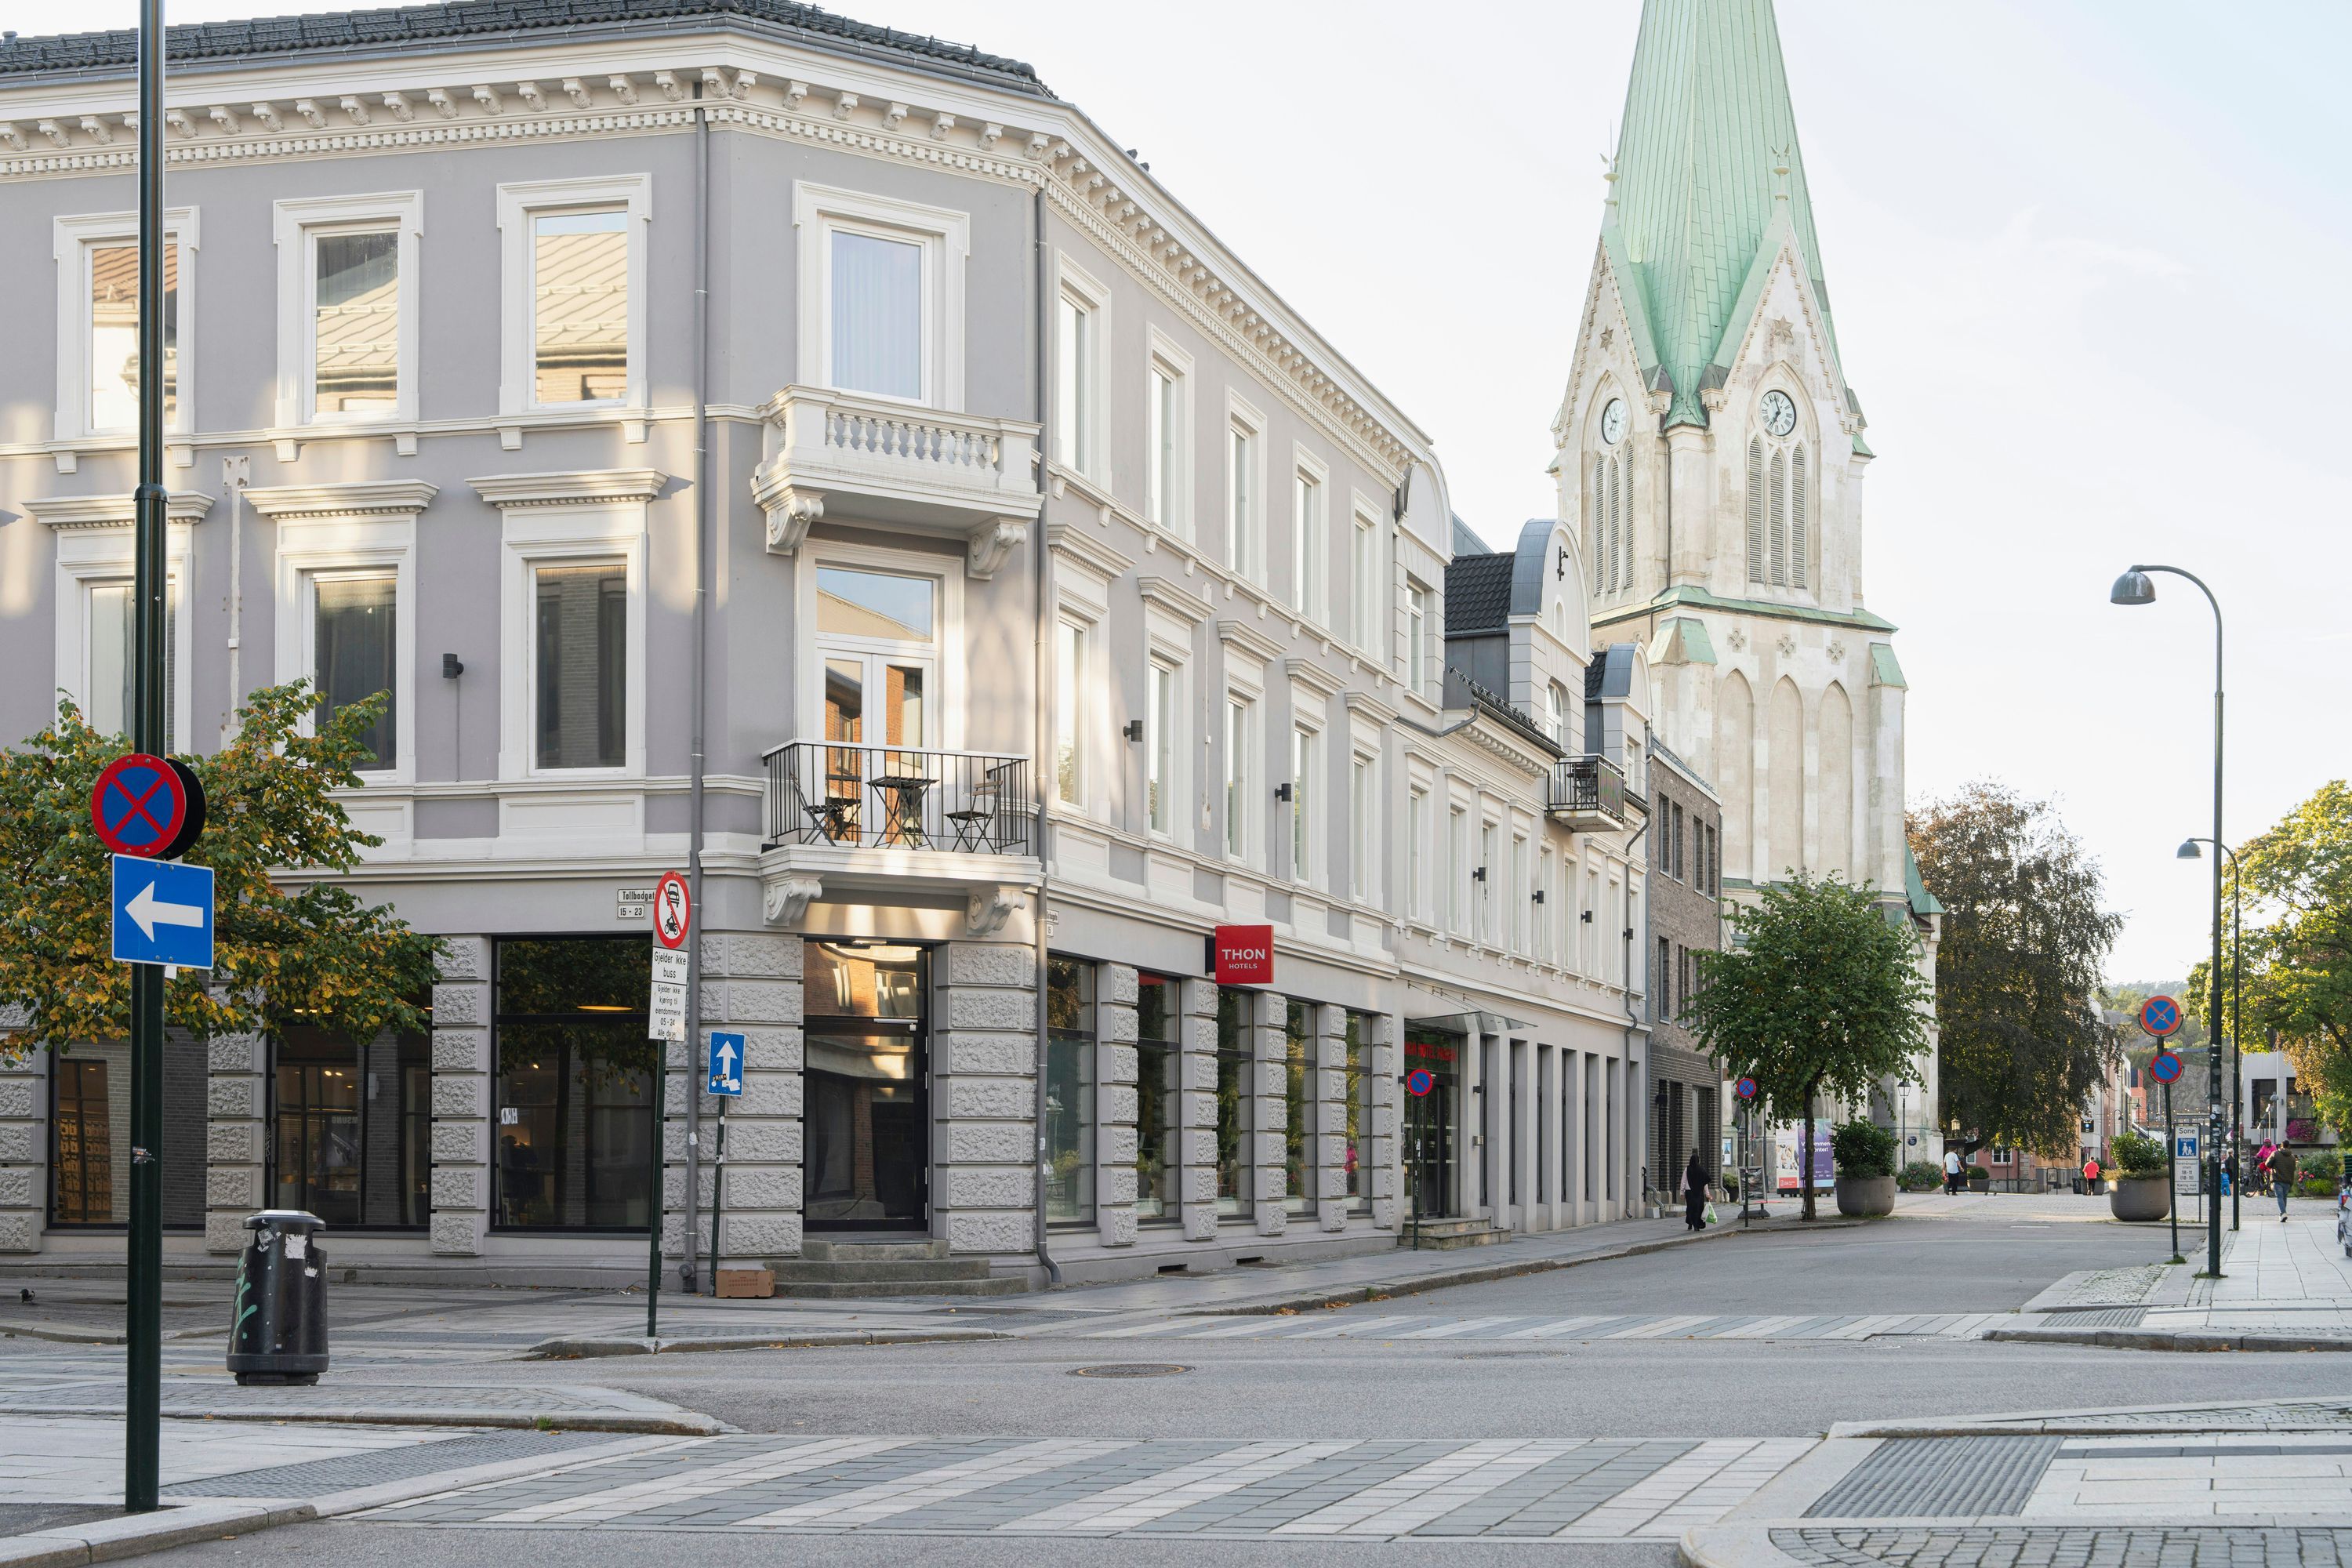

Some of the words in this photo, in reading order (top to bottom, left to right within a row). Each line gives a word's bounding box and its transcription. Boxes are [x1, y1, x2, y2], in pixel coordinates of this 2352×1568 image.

[622, 891, 655, 901] Tollbodgat
[620, 907, 626, 916] 15
[634, 907, 643, 916] 23
[655, 951, 673, 964] Gjelder
[675, 954, 687, 965] ikke
[1221, 949, 1265, 960] THON
[663, 967, 677, 978] buss
[658, 985, 671, 993] Gjelder
